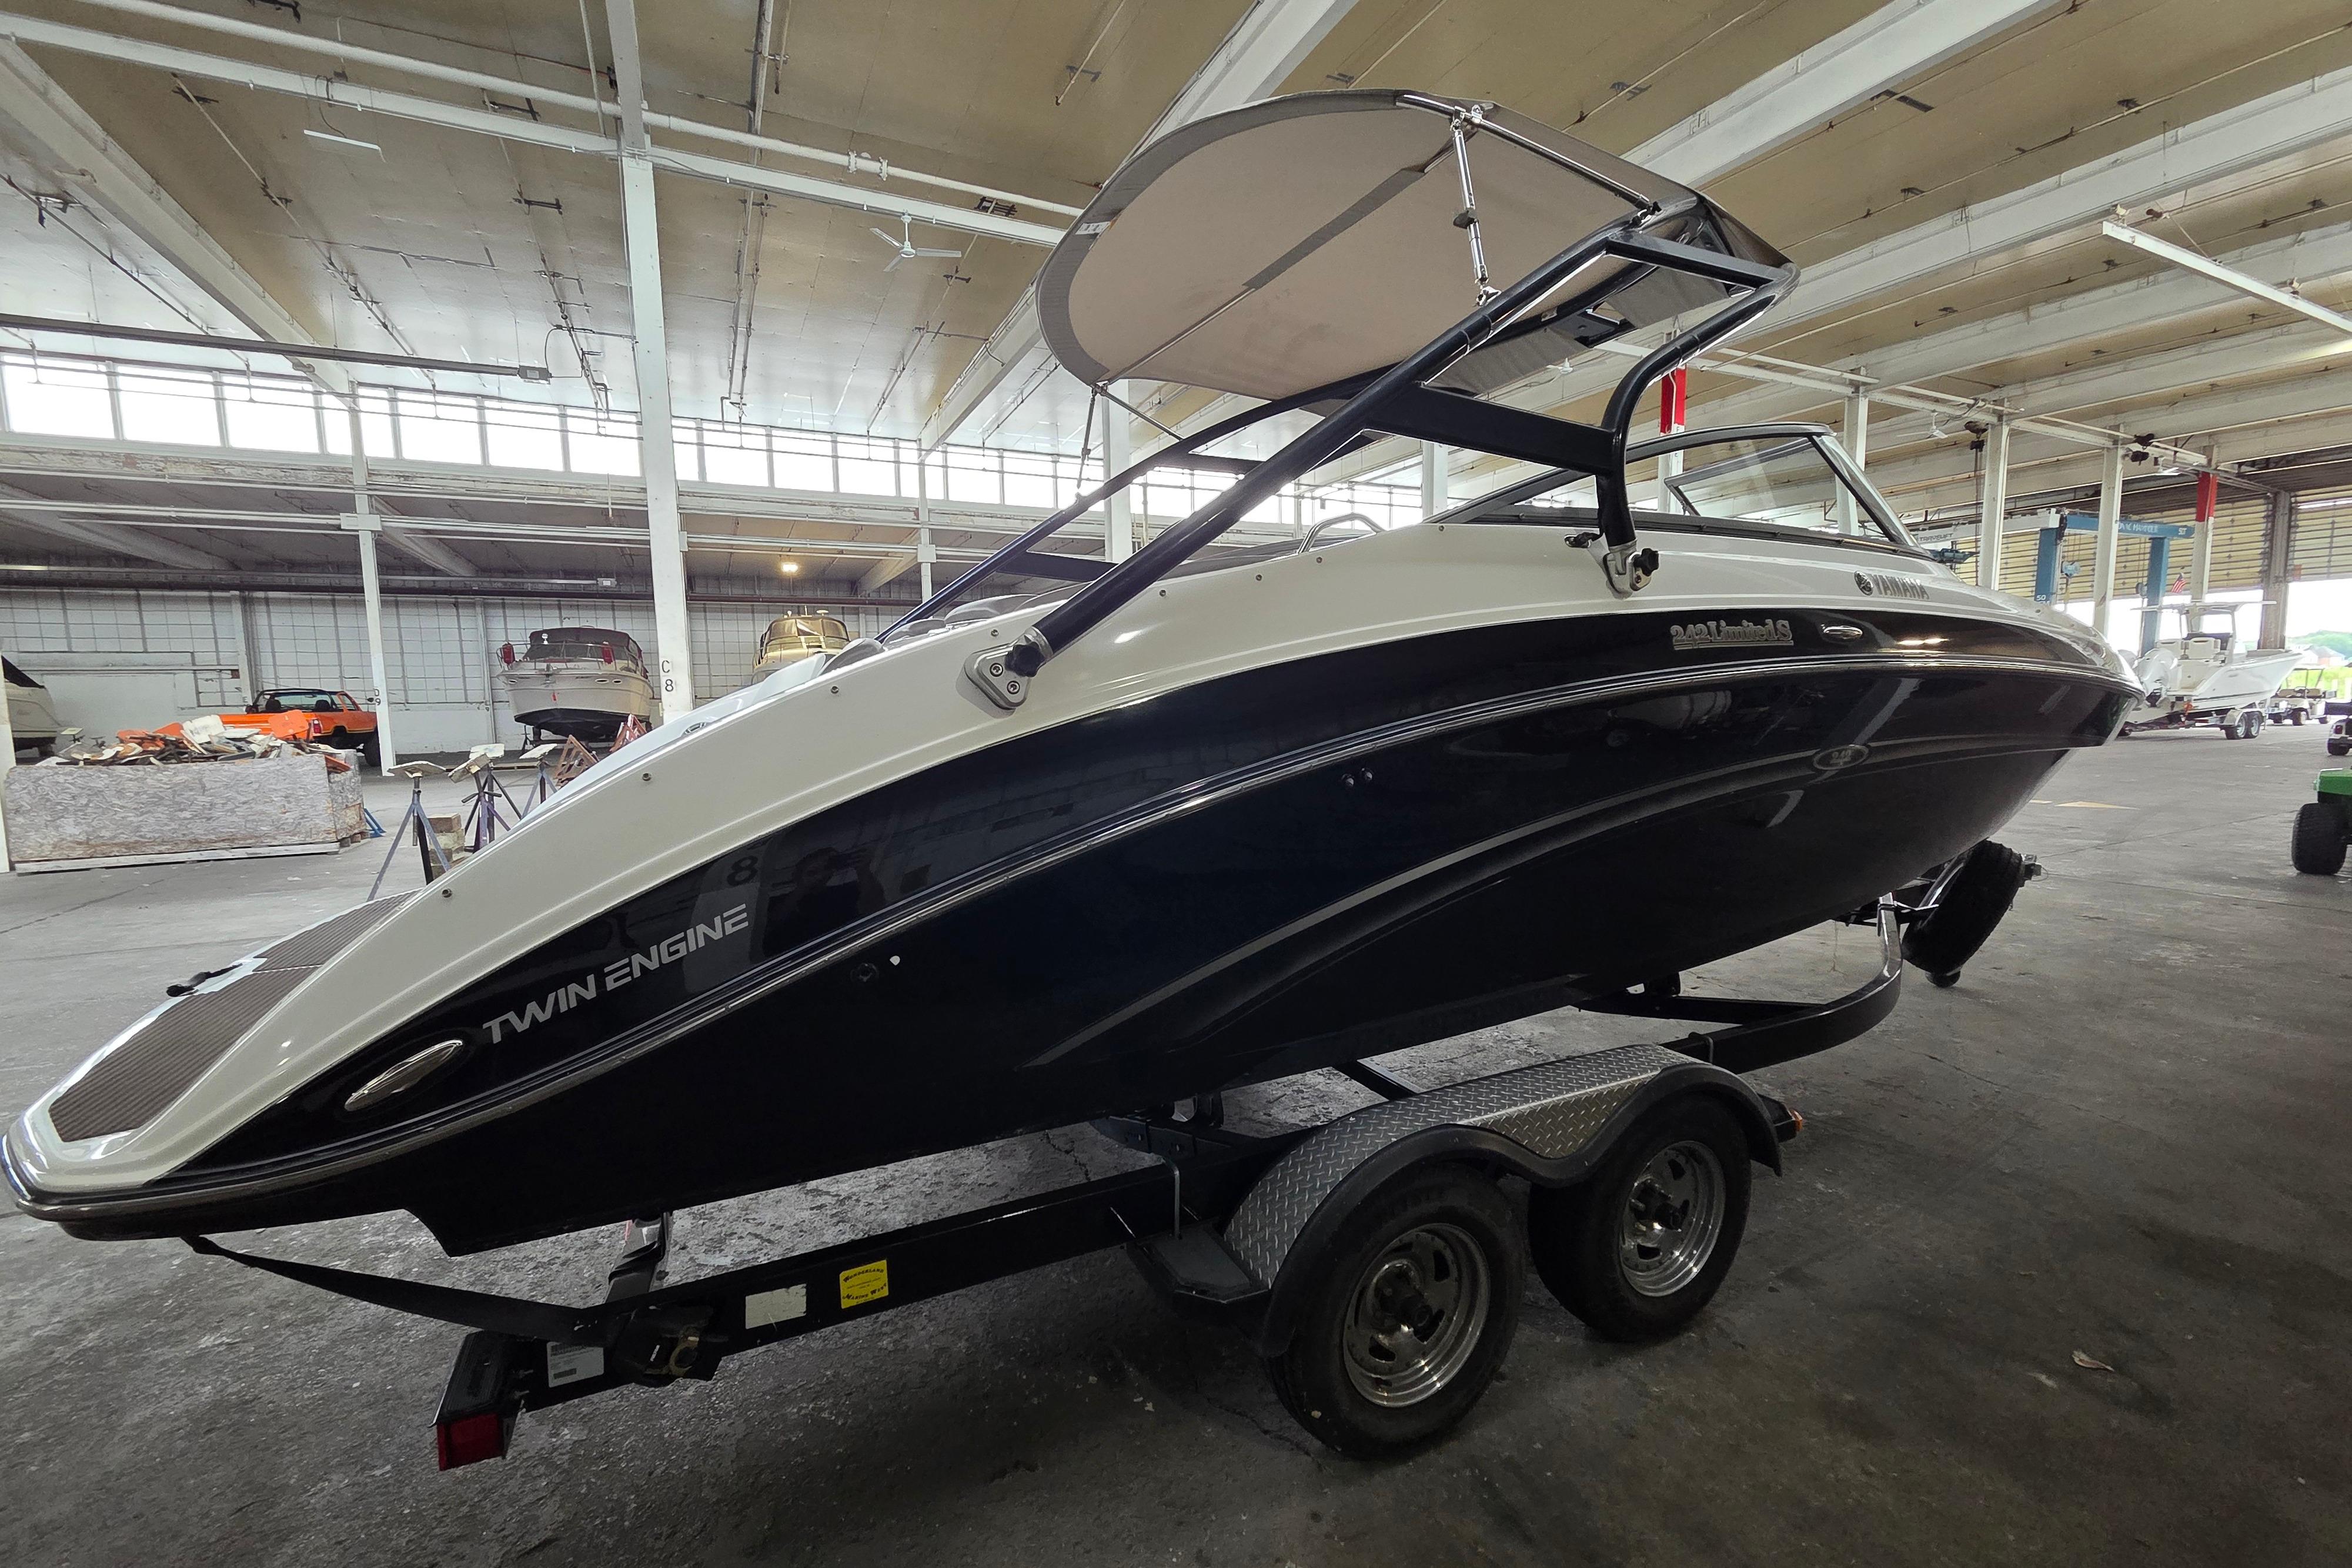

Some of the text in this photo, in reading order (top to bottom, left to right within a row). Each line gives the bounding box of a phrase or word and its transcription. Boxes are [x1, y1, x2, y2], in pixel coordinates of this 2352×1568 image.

[1920, 533, 1953, 541] TRAVELIFT
[1870, 574, 1929, 599] YAMAHA
[1670, 619, 1792, 649] 242 Limited S
[662, 660, 670, 673] C
[664, 678, 674, 692] 8
[482, 903, 749, 1044] TWIN ENGINE
